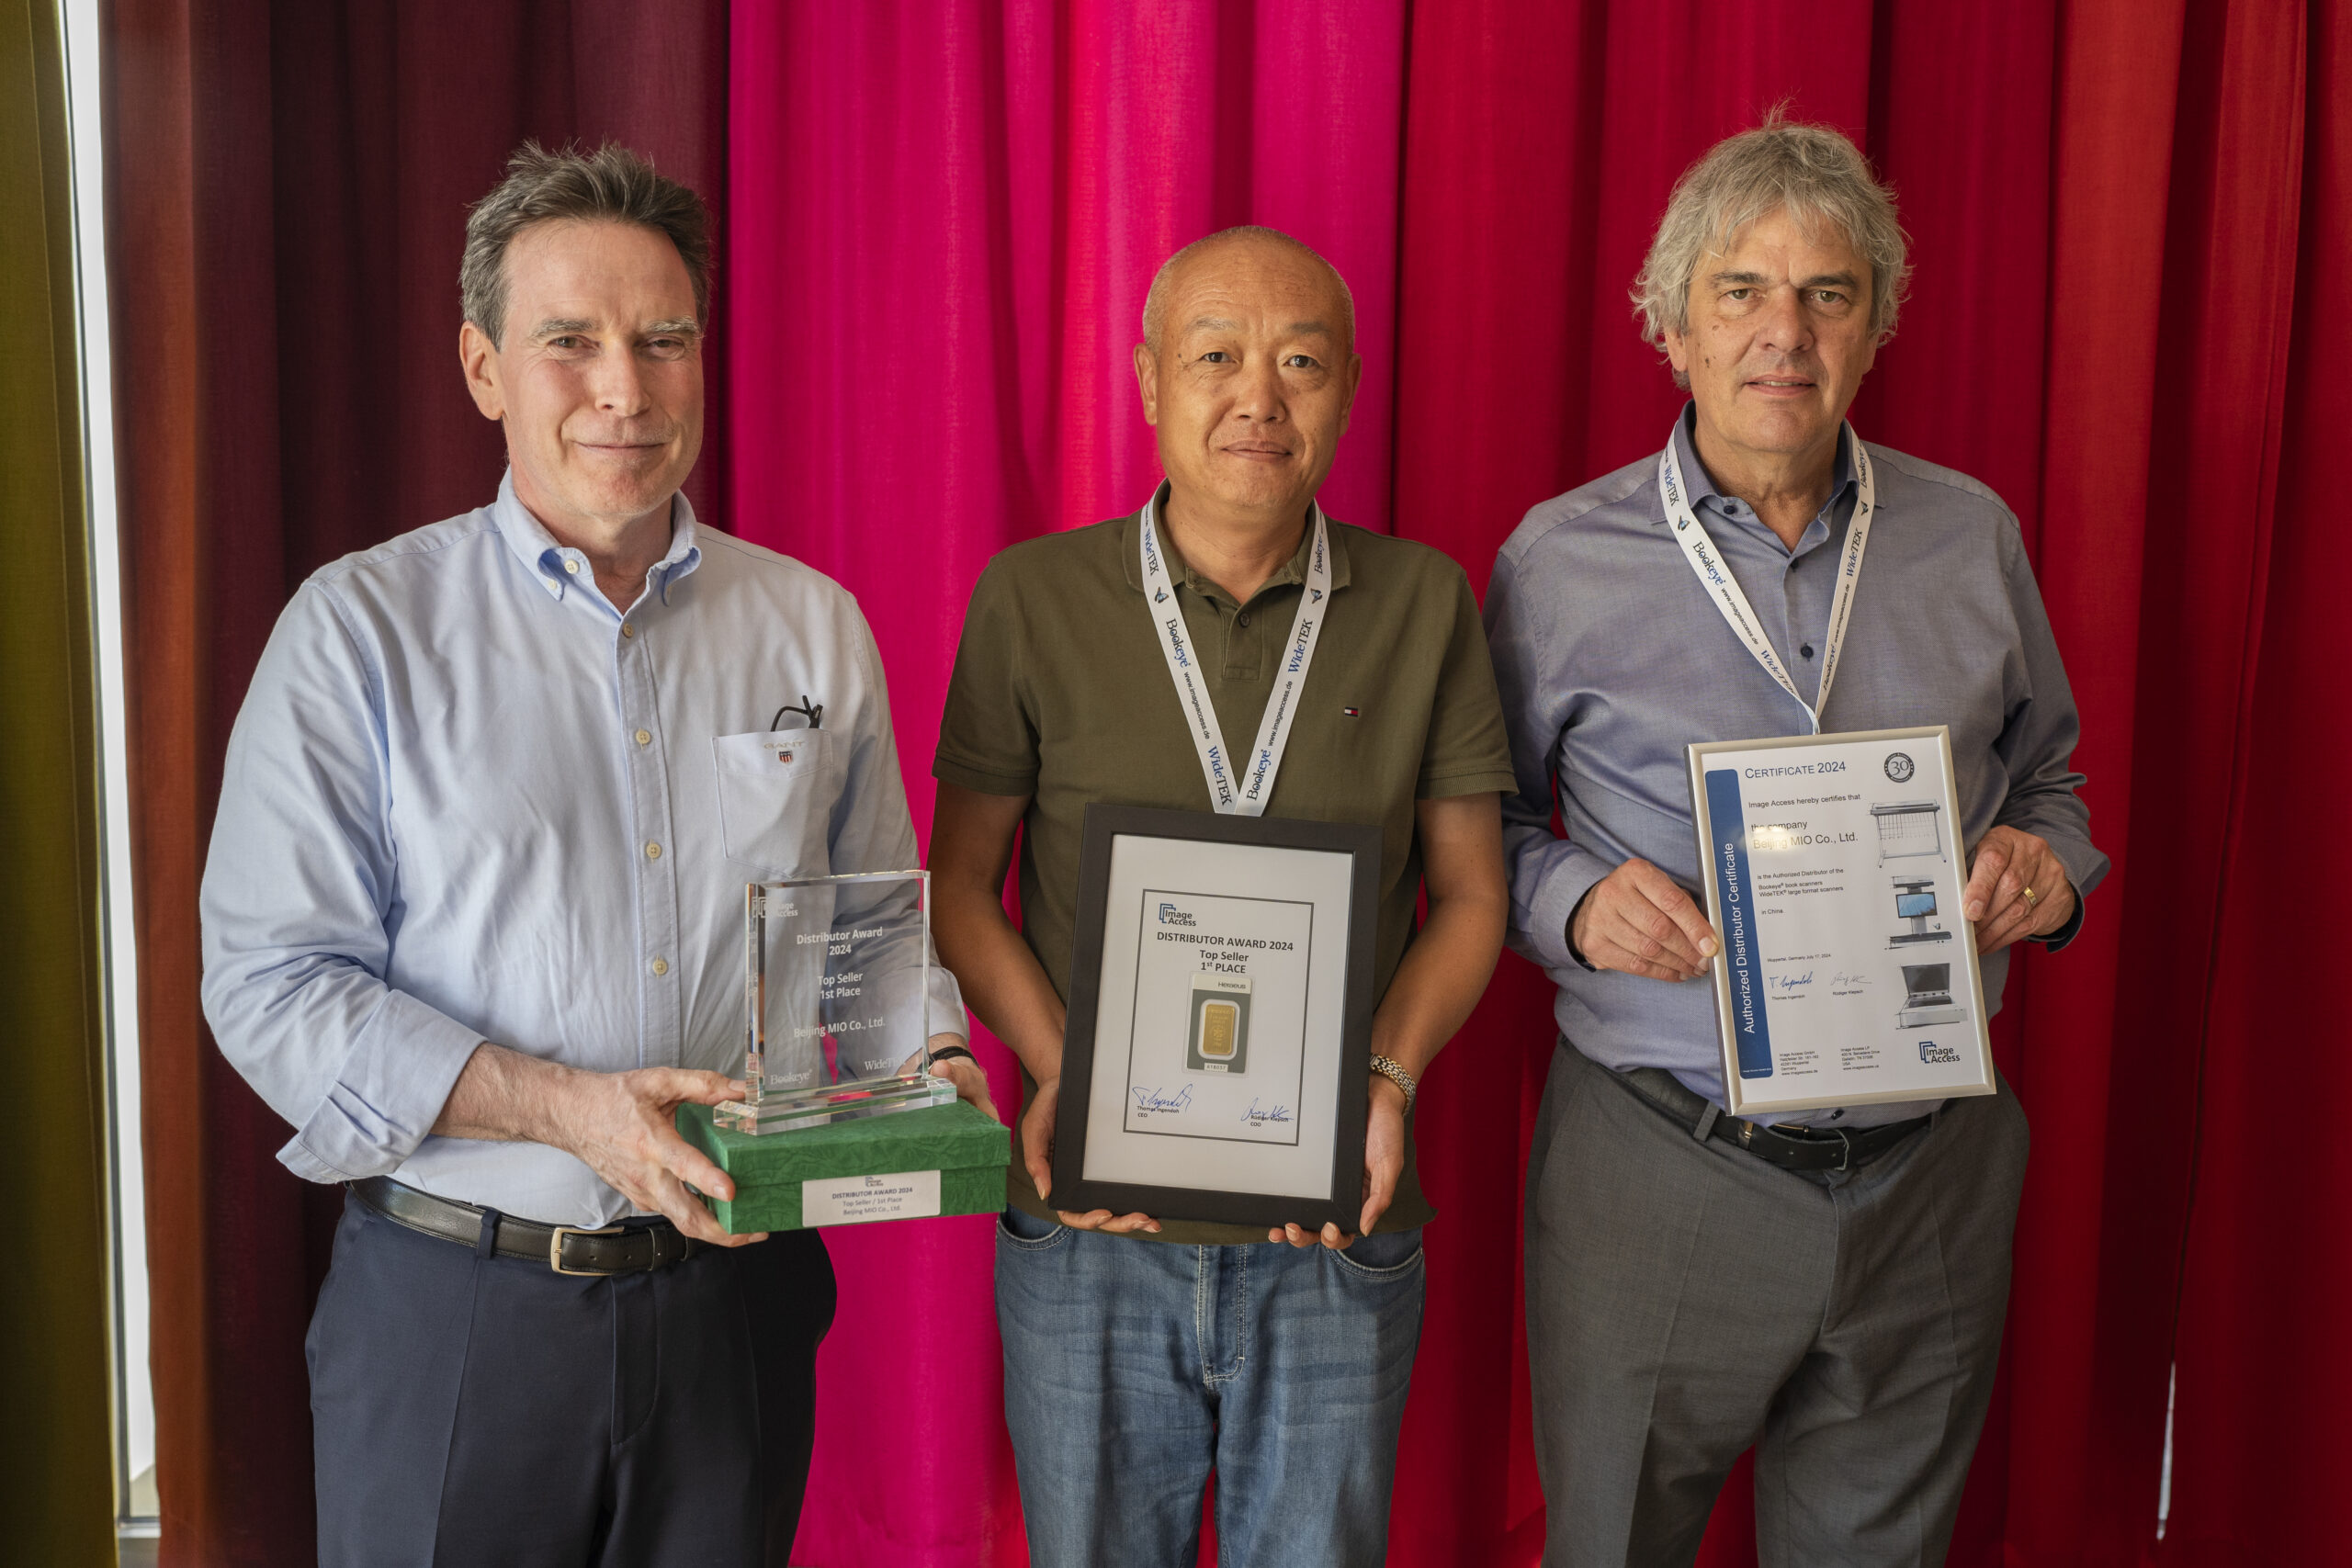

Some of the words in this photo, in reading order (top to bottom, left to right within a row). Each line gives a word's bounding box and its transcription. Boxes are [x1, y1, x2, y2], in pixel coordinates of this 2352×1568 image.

[1664, 465, 1679, 506] WideTEK
[1145, 529, 1159, 576] WideTEK
[1846, 527, 1862, 577] WideTEK
[1721, 588, 1758, 645] www.imageaccess.de
[1268, 681, 1293, 746] www.imageaccess.de
[1288, 618, 1313, 673] WideTEK
[1184, 671, 1210, 739] www.imageaccess.de
[1208, 745, 1232, 806] WideTEK
[1817, 761, 1846, 773] 2024
[1891, 761, 1909, 775] 30
[1748, 801, 1770, 809] Image
[1770, 798, 1794, 807] Access
[1796, 796, 1819, 805] hereby
[1821, 795, 1847, 803] certifies
[1753, 838, 1787, 850] Beijing
[1791, 835, 1812, 846] MIO
[1815, 834, 1837, 844] Co.,
[1839, 832, 1859, 842] Ltd.
[1724, 842, 1740, 903] Certificate
[1165, 909, 1193, 919] Image
[1168, 918, 1196, 927] Access
[797, 931, 851, 944] Distributor
[853, 927, 883, 939] Award
[1157, 931, 1224, 945] DISTRIBUTOR
[1227, 938, 1266, 949] AWARD
[1269, 941, 1294, 951] 2024
[1733, 906, 1747, 966] Distributor
[829, 944, 852, 955] 2024
[1200, 950, 1218, 961] Top
[1221, 952, 1249, 962] Seller
[1201, 962, 1213, 971] 1st
[1215, 963, 1246, 974] PLACE
[818, 976, 835, 987] Top
[837, 972, 863, 983] Seller
[820, 990, 834, 999] 1st
[836, 987, 861, 998] Place
[1737, 970, 1756, 1034] Authorized
[794, 1026, 826, 1038] Beijing
[828, 1021, 847, 1033] MIO
[849, 1021, 865, 1031] Co.,
[868, 1017, 886, 1028] Ltd.
[1927, 1047, 1954, 1056] Image
[1931, 1055, 1961, 1064] Access
[832, 1190, 872, 1200] DISTRIBUTOR
